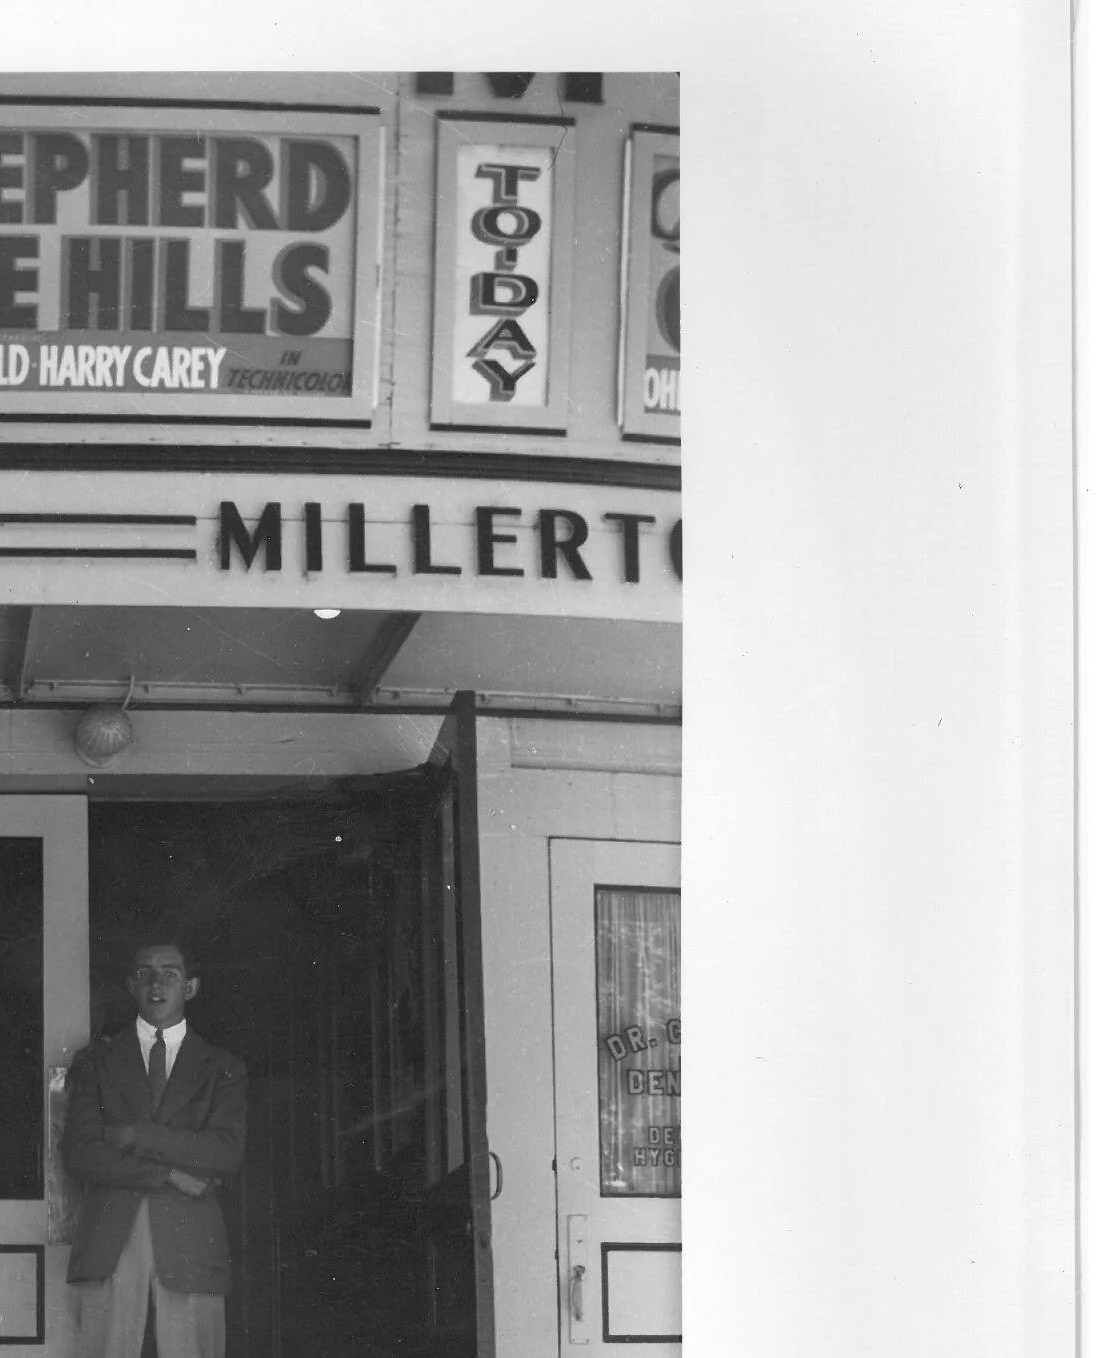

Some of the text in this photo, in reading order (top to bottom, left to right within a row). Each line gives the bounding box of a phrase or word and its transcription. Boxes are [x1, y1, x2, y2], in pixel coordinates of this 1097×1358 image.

[62, 236, 332, 336] HILLS
[39, 345, 127, 388] HARRY
[133, 346, 227, 389] CAREY
[280, 350, 301, 366] IN
[219, 501, 682, 583] MILLERT
[605, 1026, 659, 1062] DR.
[648, 1126, 681, 1145] DE
[633, 1146, 681, 1168] HYG
